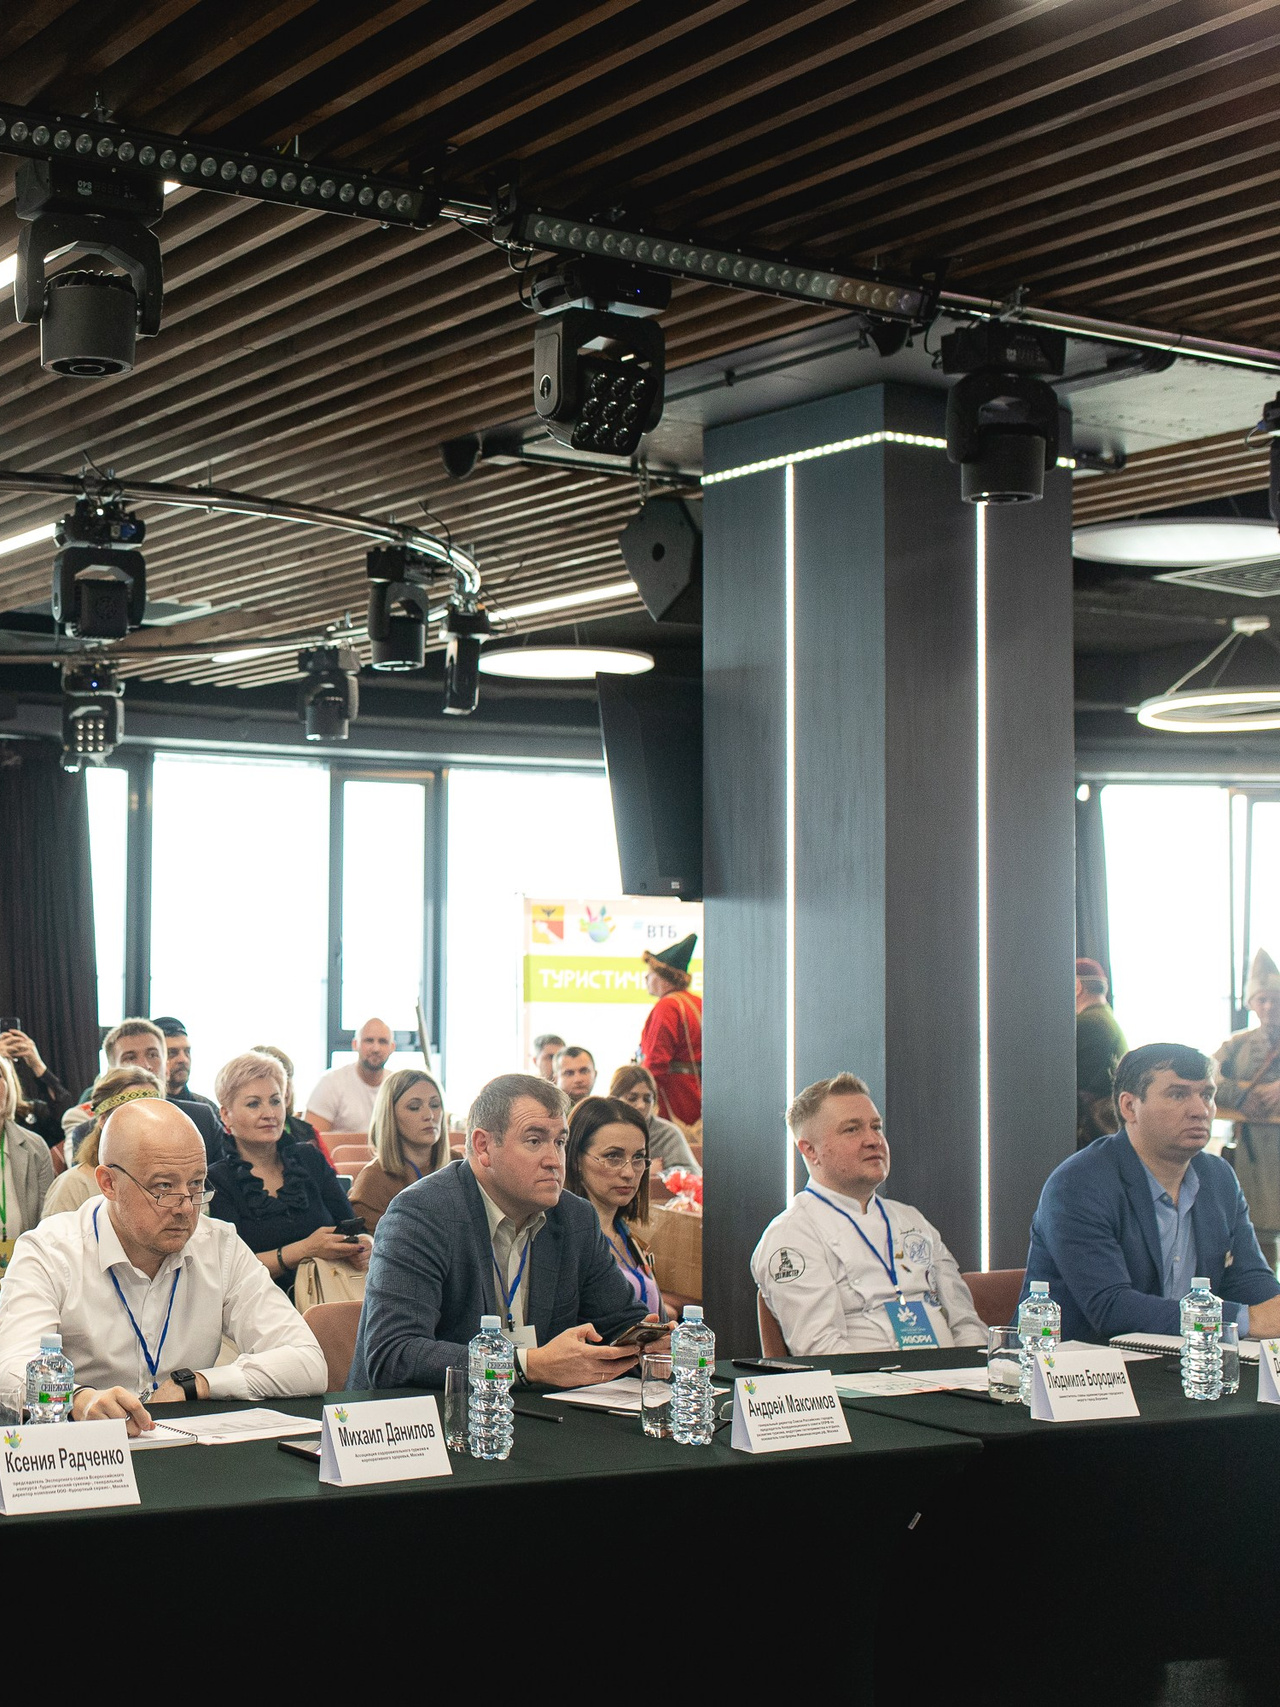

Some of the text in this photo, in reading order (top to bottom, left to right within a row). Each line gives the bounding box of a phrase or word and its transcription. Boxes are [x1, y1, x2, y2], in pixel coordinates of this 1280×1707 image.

[647, 925, 677, 938] ВТБ
[1046, 1369, 1126, 1391] Людмила Бородина
[748, 1394, 836, 1419] Андрей Максимов
[338, 1422, 435, 1447] Михаил Данилов
[5, 1448, 124, 1473] Ксения Радченко
